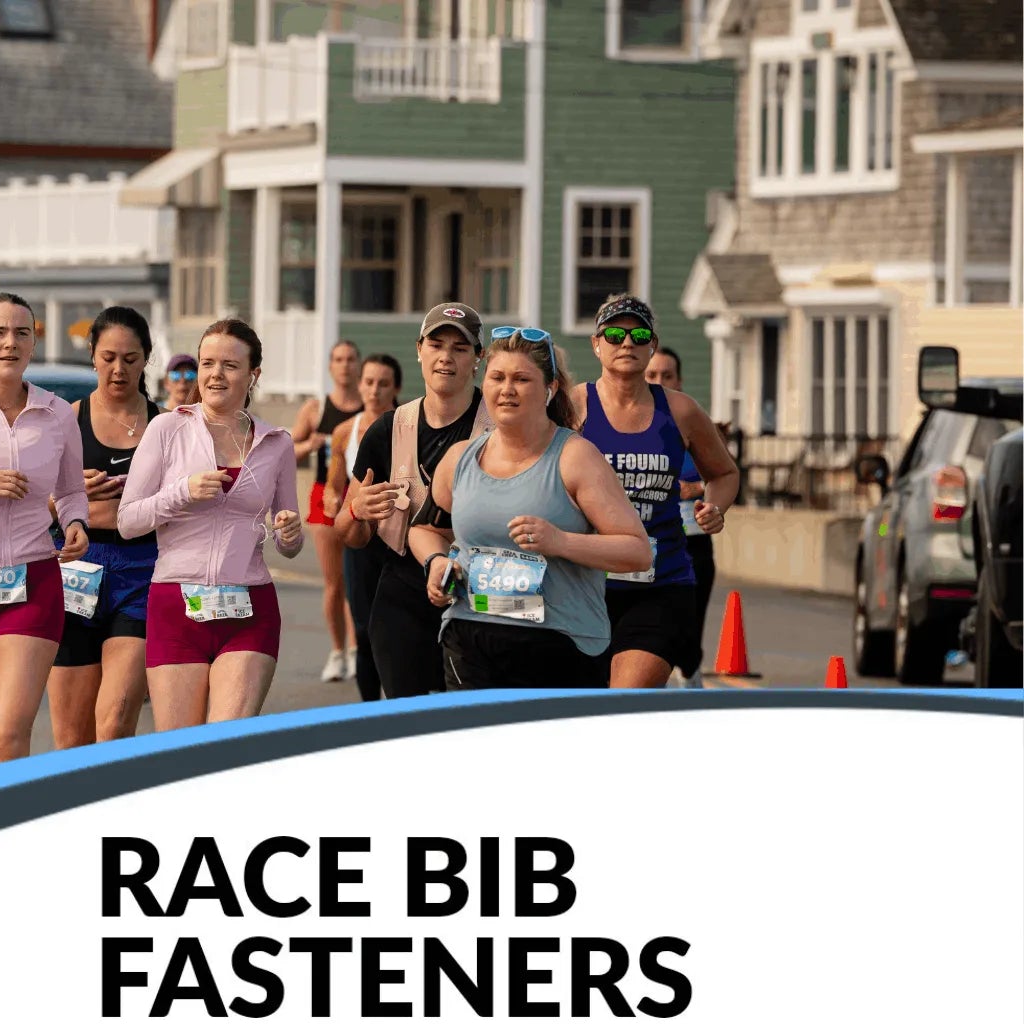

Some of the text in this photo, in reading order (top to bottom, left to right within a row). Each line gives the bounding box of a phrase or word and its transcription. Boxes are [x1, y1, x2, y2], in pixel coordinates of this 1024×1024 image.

[617, 453, 670, 472] FOUND
[637, 489, 669, 502] ACROSS
[477, 573, 530, 593] 5490
